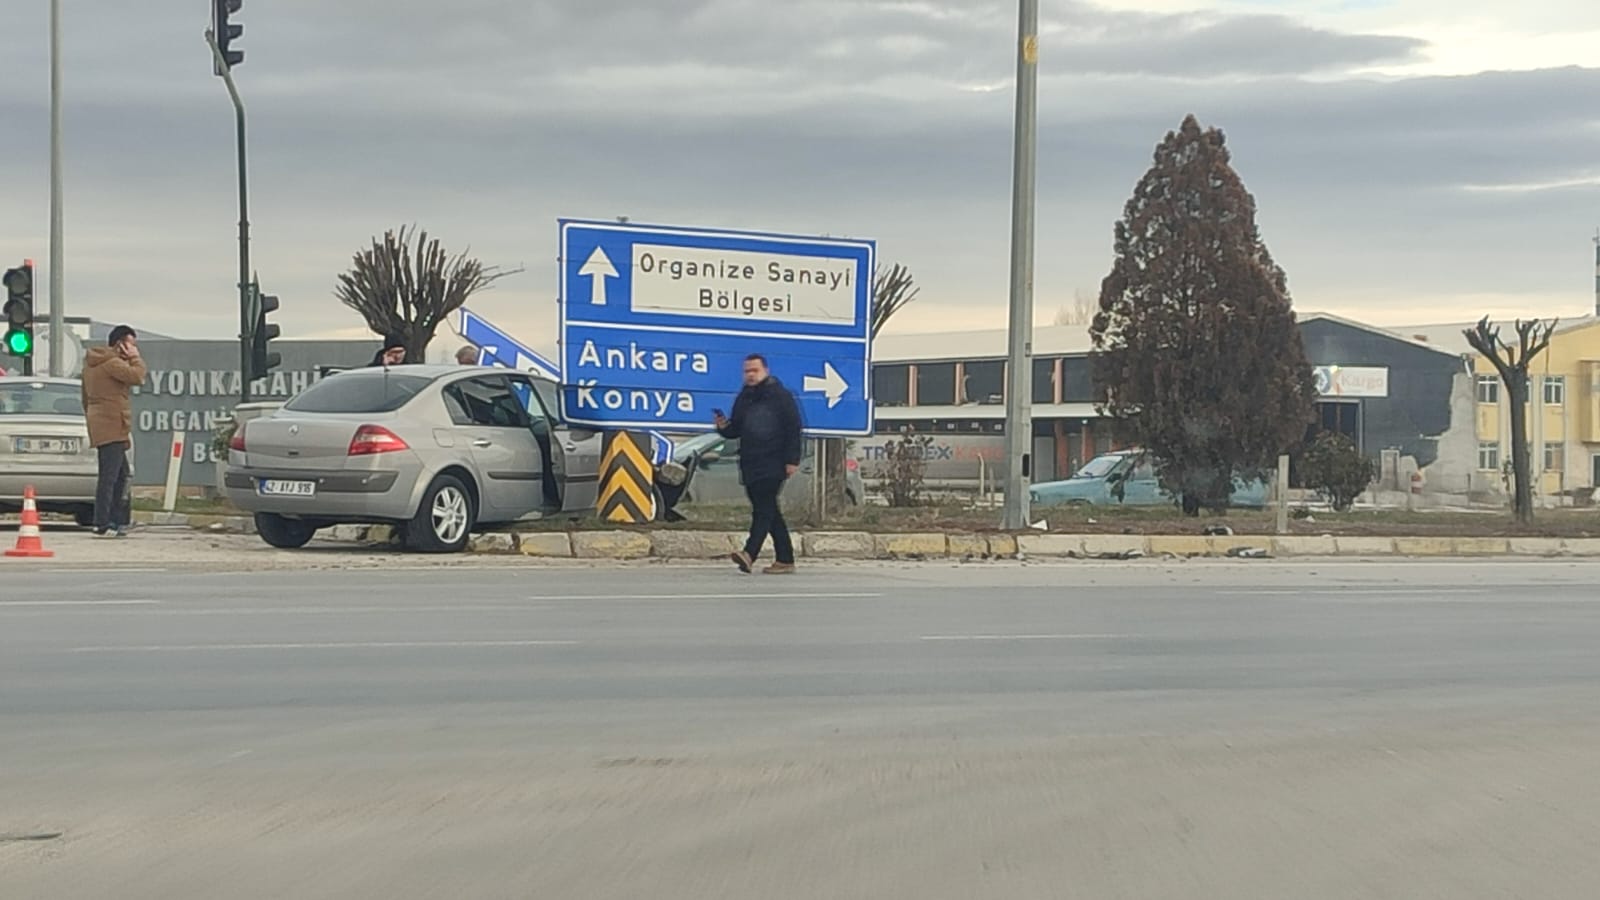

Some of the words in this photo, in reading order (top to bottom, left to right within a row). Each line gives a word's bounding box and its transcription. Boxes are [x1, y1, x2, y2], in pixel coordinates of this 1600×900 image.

[640, 252, 756, 280] Organize
[767, 262, 851, 291] Sanayi
[699, 288, 792, 316] Bölgesi
[578, 339, 709, 373] Ankara
[576, 378, 695, 417] Konya
